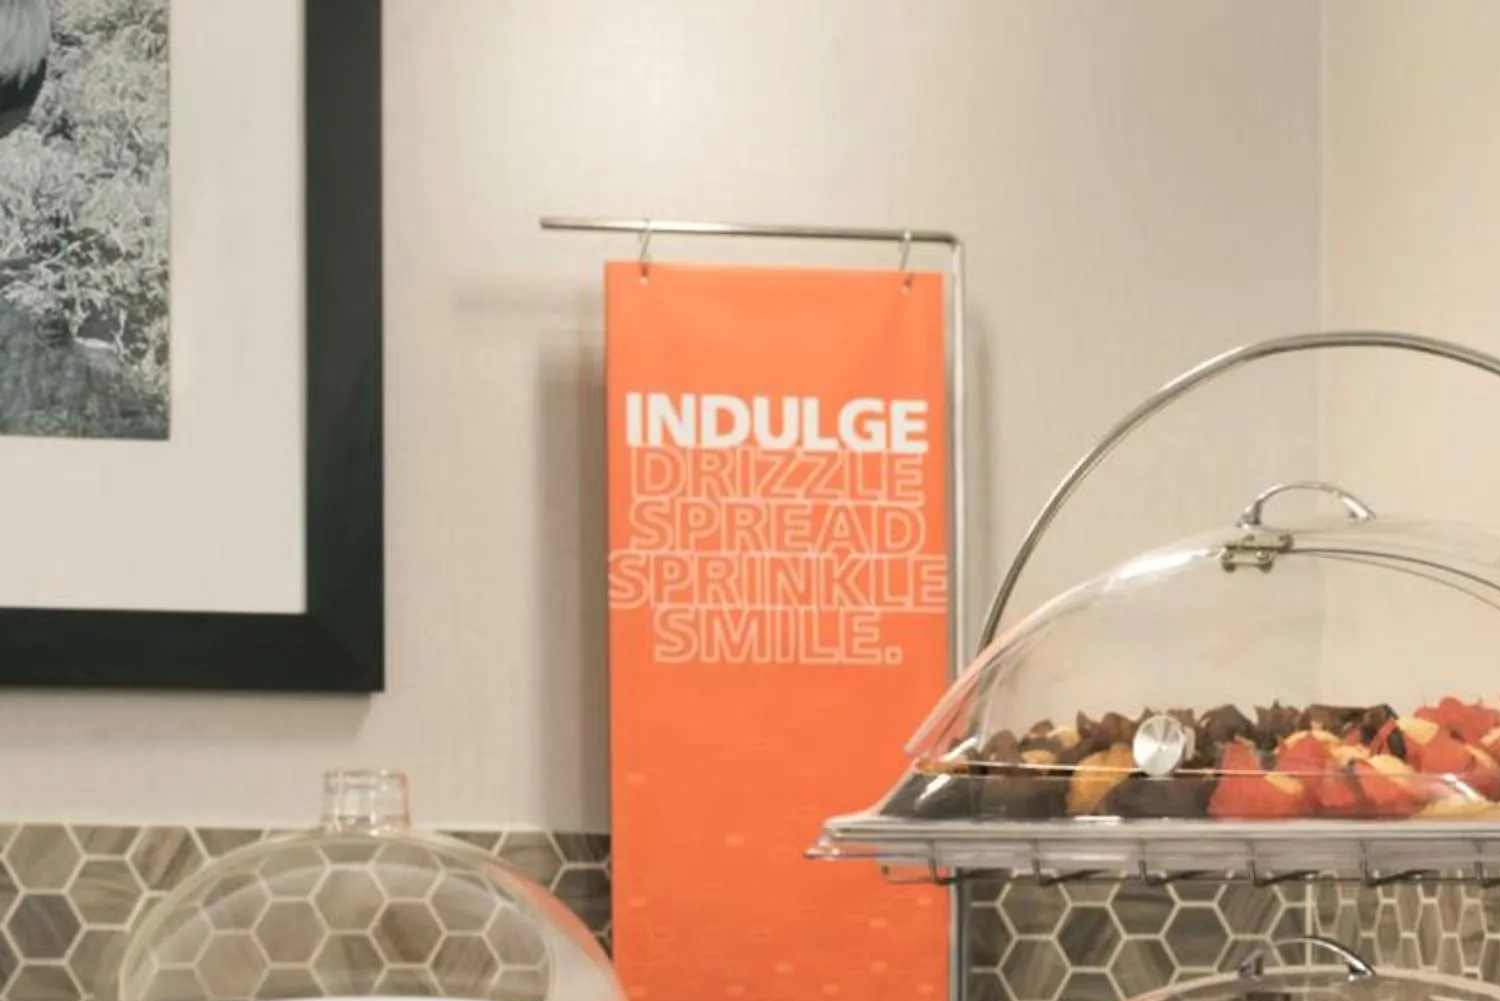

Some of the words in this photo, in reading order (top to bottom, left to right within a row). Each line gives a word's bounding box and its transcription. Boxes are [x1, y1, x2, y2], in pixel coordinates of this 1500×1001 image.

[625, 392, 929, 453] INDULGE
[631, 448, 925, 506] DRIZZLE
[629, 499, 926, 559] SPREAD
[607, 550, 948, 613] SPRINKLE
[653, 604, 902, 664] SMILE.
